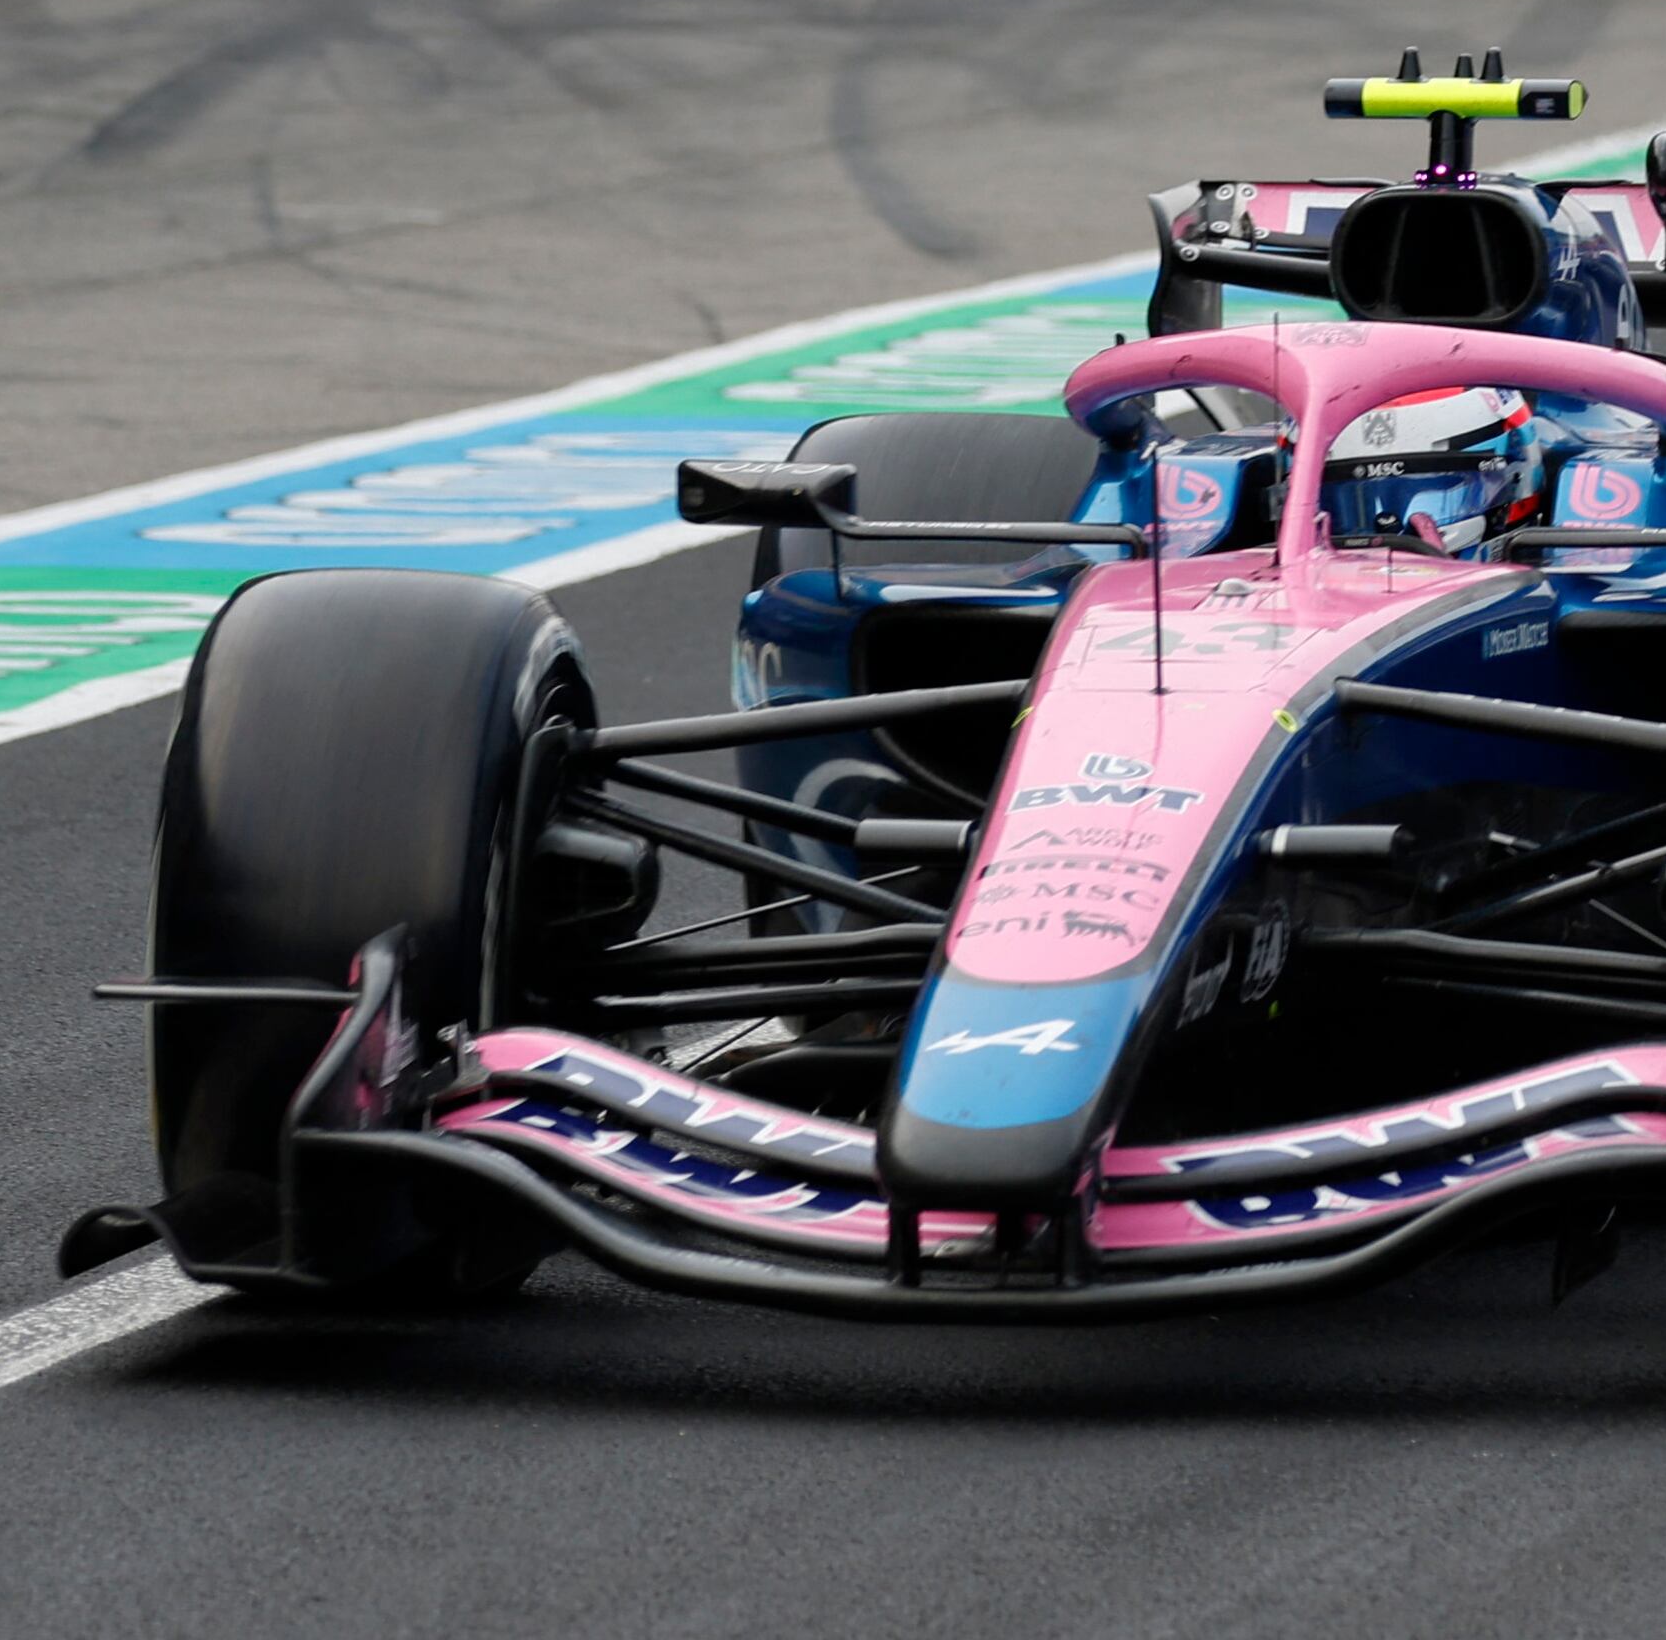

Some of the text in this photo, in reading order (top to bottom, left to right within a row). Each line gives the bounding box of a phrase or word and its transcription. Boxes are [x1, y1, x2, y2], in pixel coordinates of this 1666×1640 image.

[1366, 462, 1405, 478] MSC
[1004, 783, 1206, 816] BWT
[977, 853, 1172, 882] PIRELLI
[1031, 882, 1161, 912] MSC
[957, 912, 1052, 938] eni
